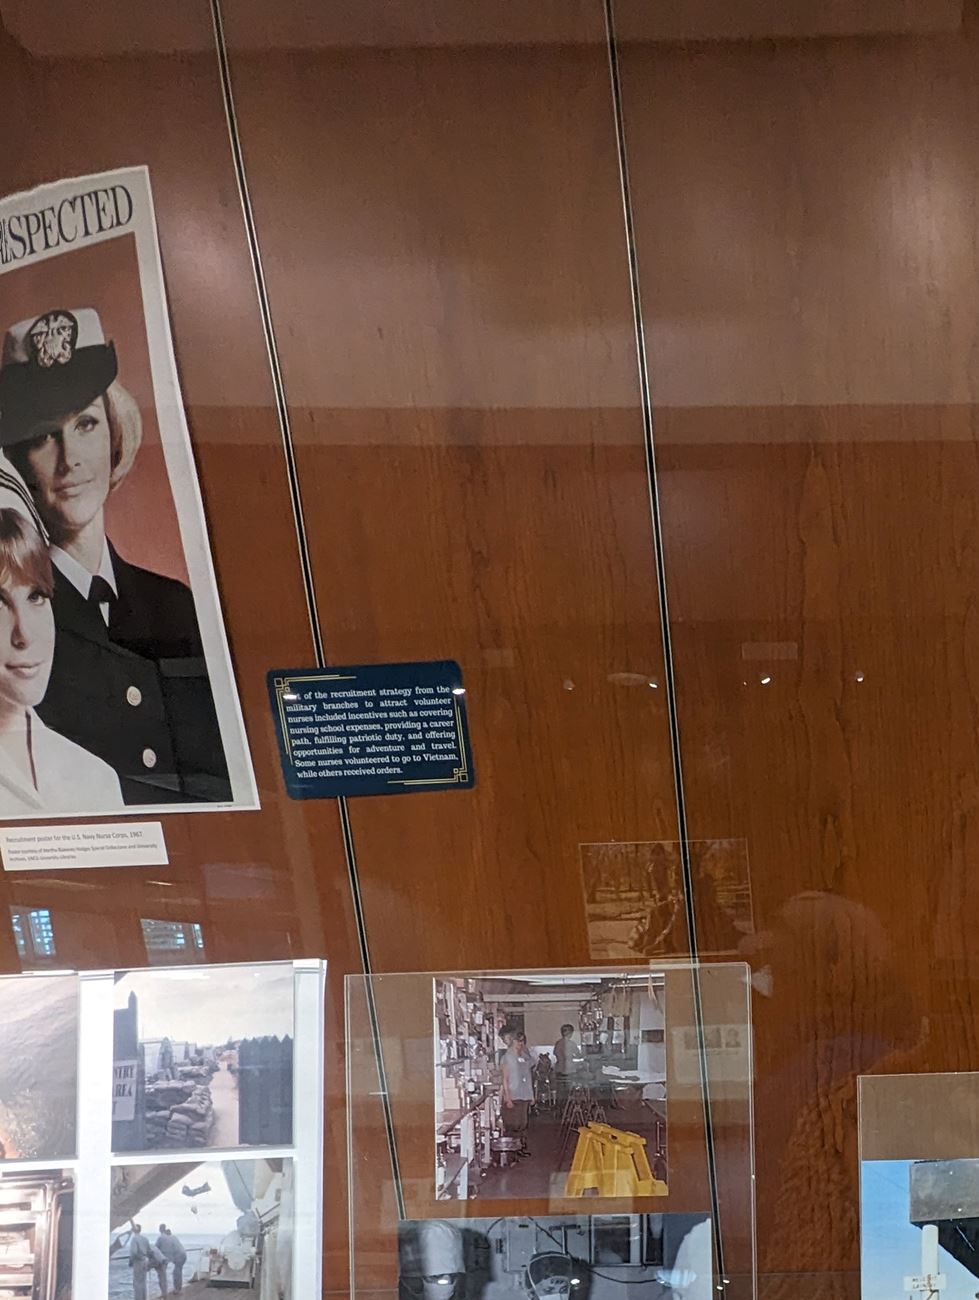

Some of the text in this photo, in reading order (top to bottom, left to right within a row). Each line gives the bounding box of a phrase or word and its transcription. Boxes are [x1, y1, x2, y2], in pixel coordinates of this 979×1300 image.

[286, 696, 452, 713] military branches to attract volunteer
[293, 746, 344, 758] opportunities
[348, 745, 361, 754] for
[365, 743, 405, 753] adventure
[410, 742, 426, 751] and
[295, 758, 316, 767] Some
[344, 755, 390, 765] volunteered
[391, 755, 400, 763] to
[401, 756, 412, 764] go
[412, 754, 422, 762] to
[296, 769, 318, 778] while
[318, 768, 343, 777] others
[343, 766, 376, 775] received
